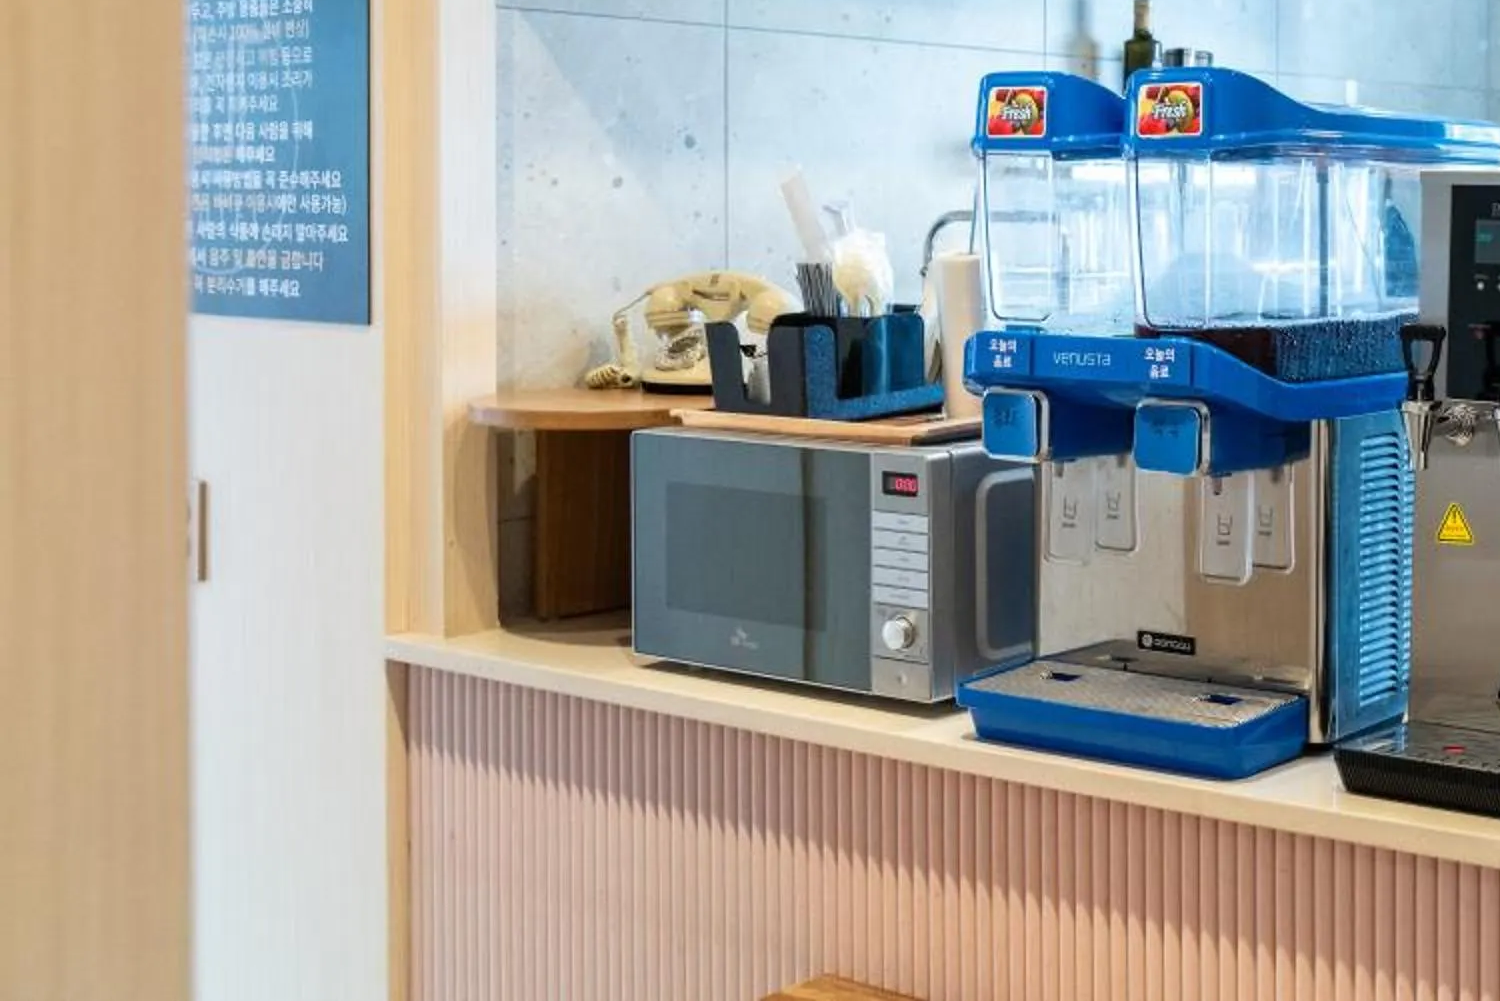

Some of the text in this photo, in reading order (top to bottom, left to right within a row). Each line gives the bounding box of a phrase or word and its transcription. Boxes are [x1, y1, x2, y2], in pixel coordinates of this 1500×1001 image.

[1001, 105, 1031, 121] Fresh
[1153, 102, 1187, 120] Fresh
[1145, 347, 1175, 362] 오늘의
